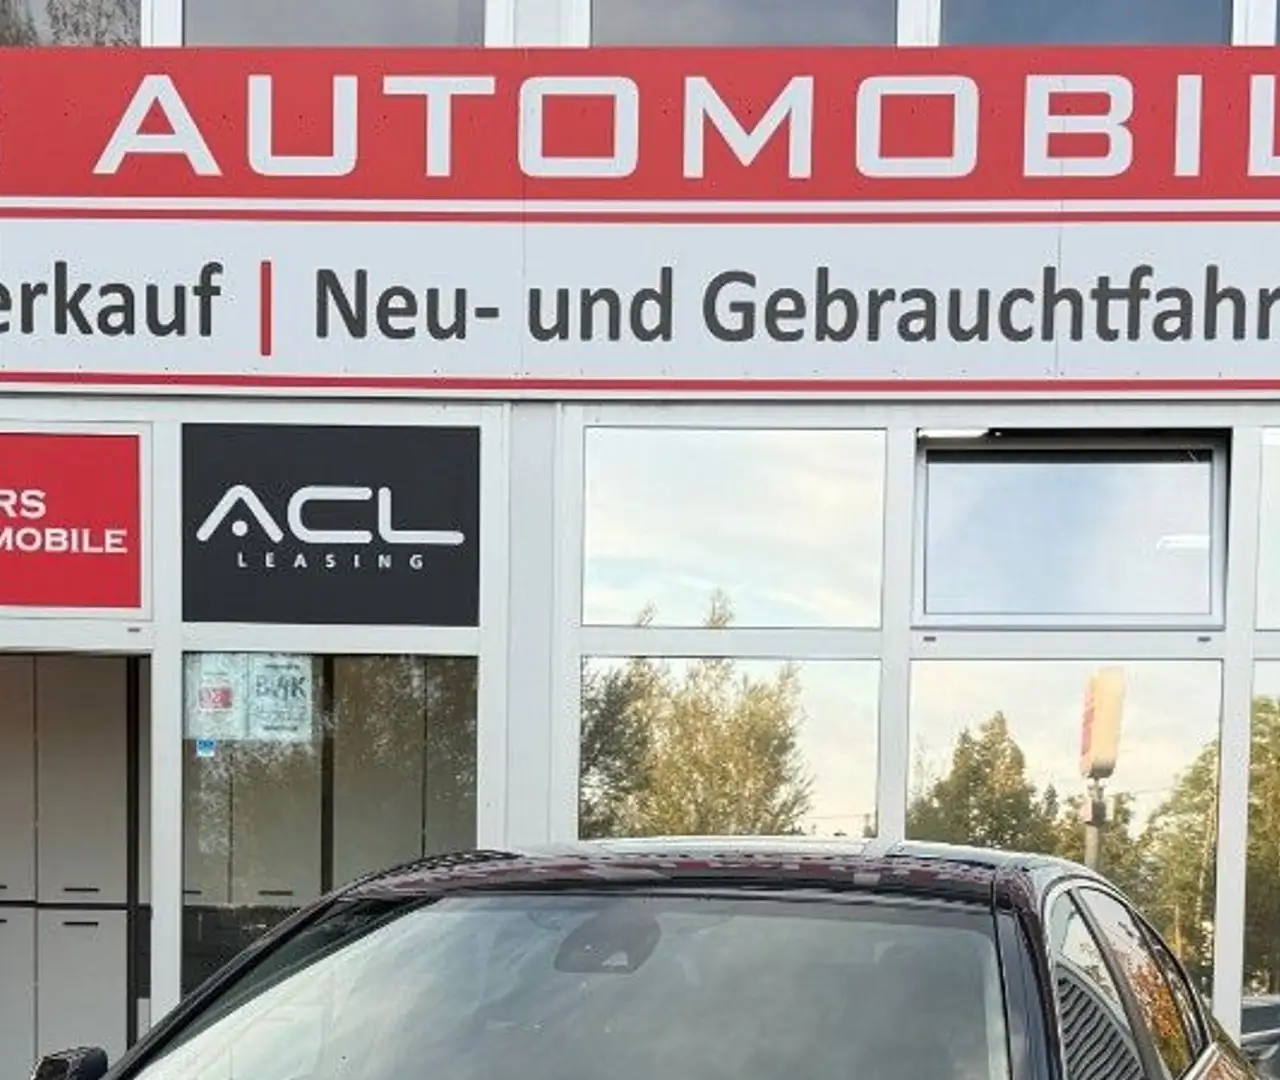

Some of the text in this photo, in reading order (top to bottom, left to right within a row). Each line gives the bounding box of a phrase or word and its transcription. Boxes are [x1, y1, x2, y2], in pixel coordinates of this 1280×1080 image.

[316, 269, 499, 340] Neu-
[528, 266, 673, 342] und
[196, 484, 465, 546] ACL
[237, 552, 424, 570] LEASING
